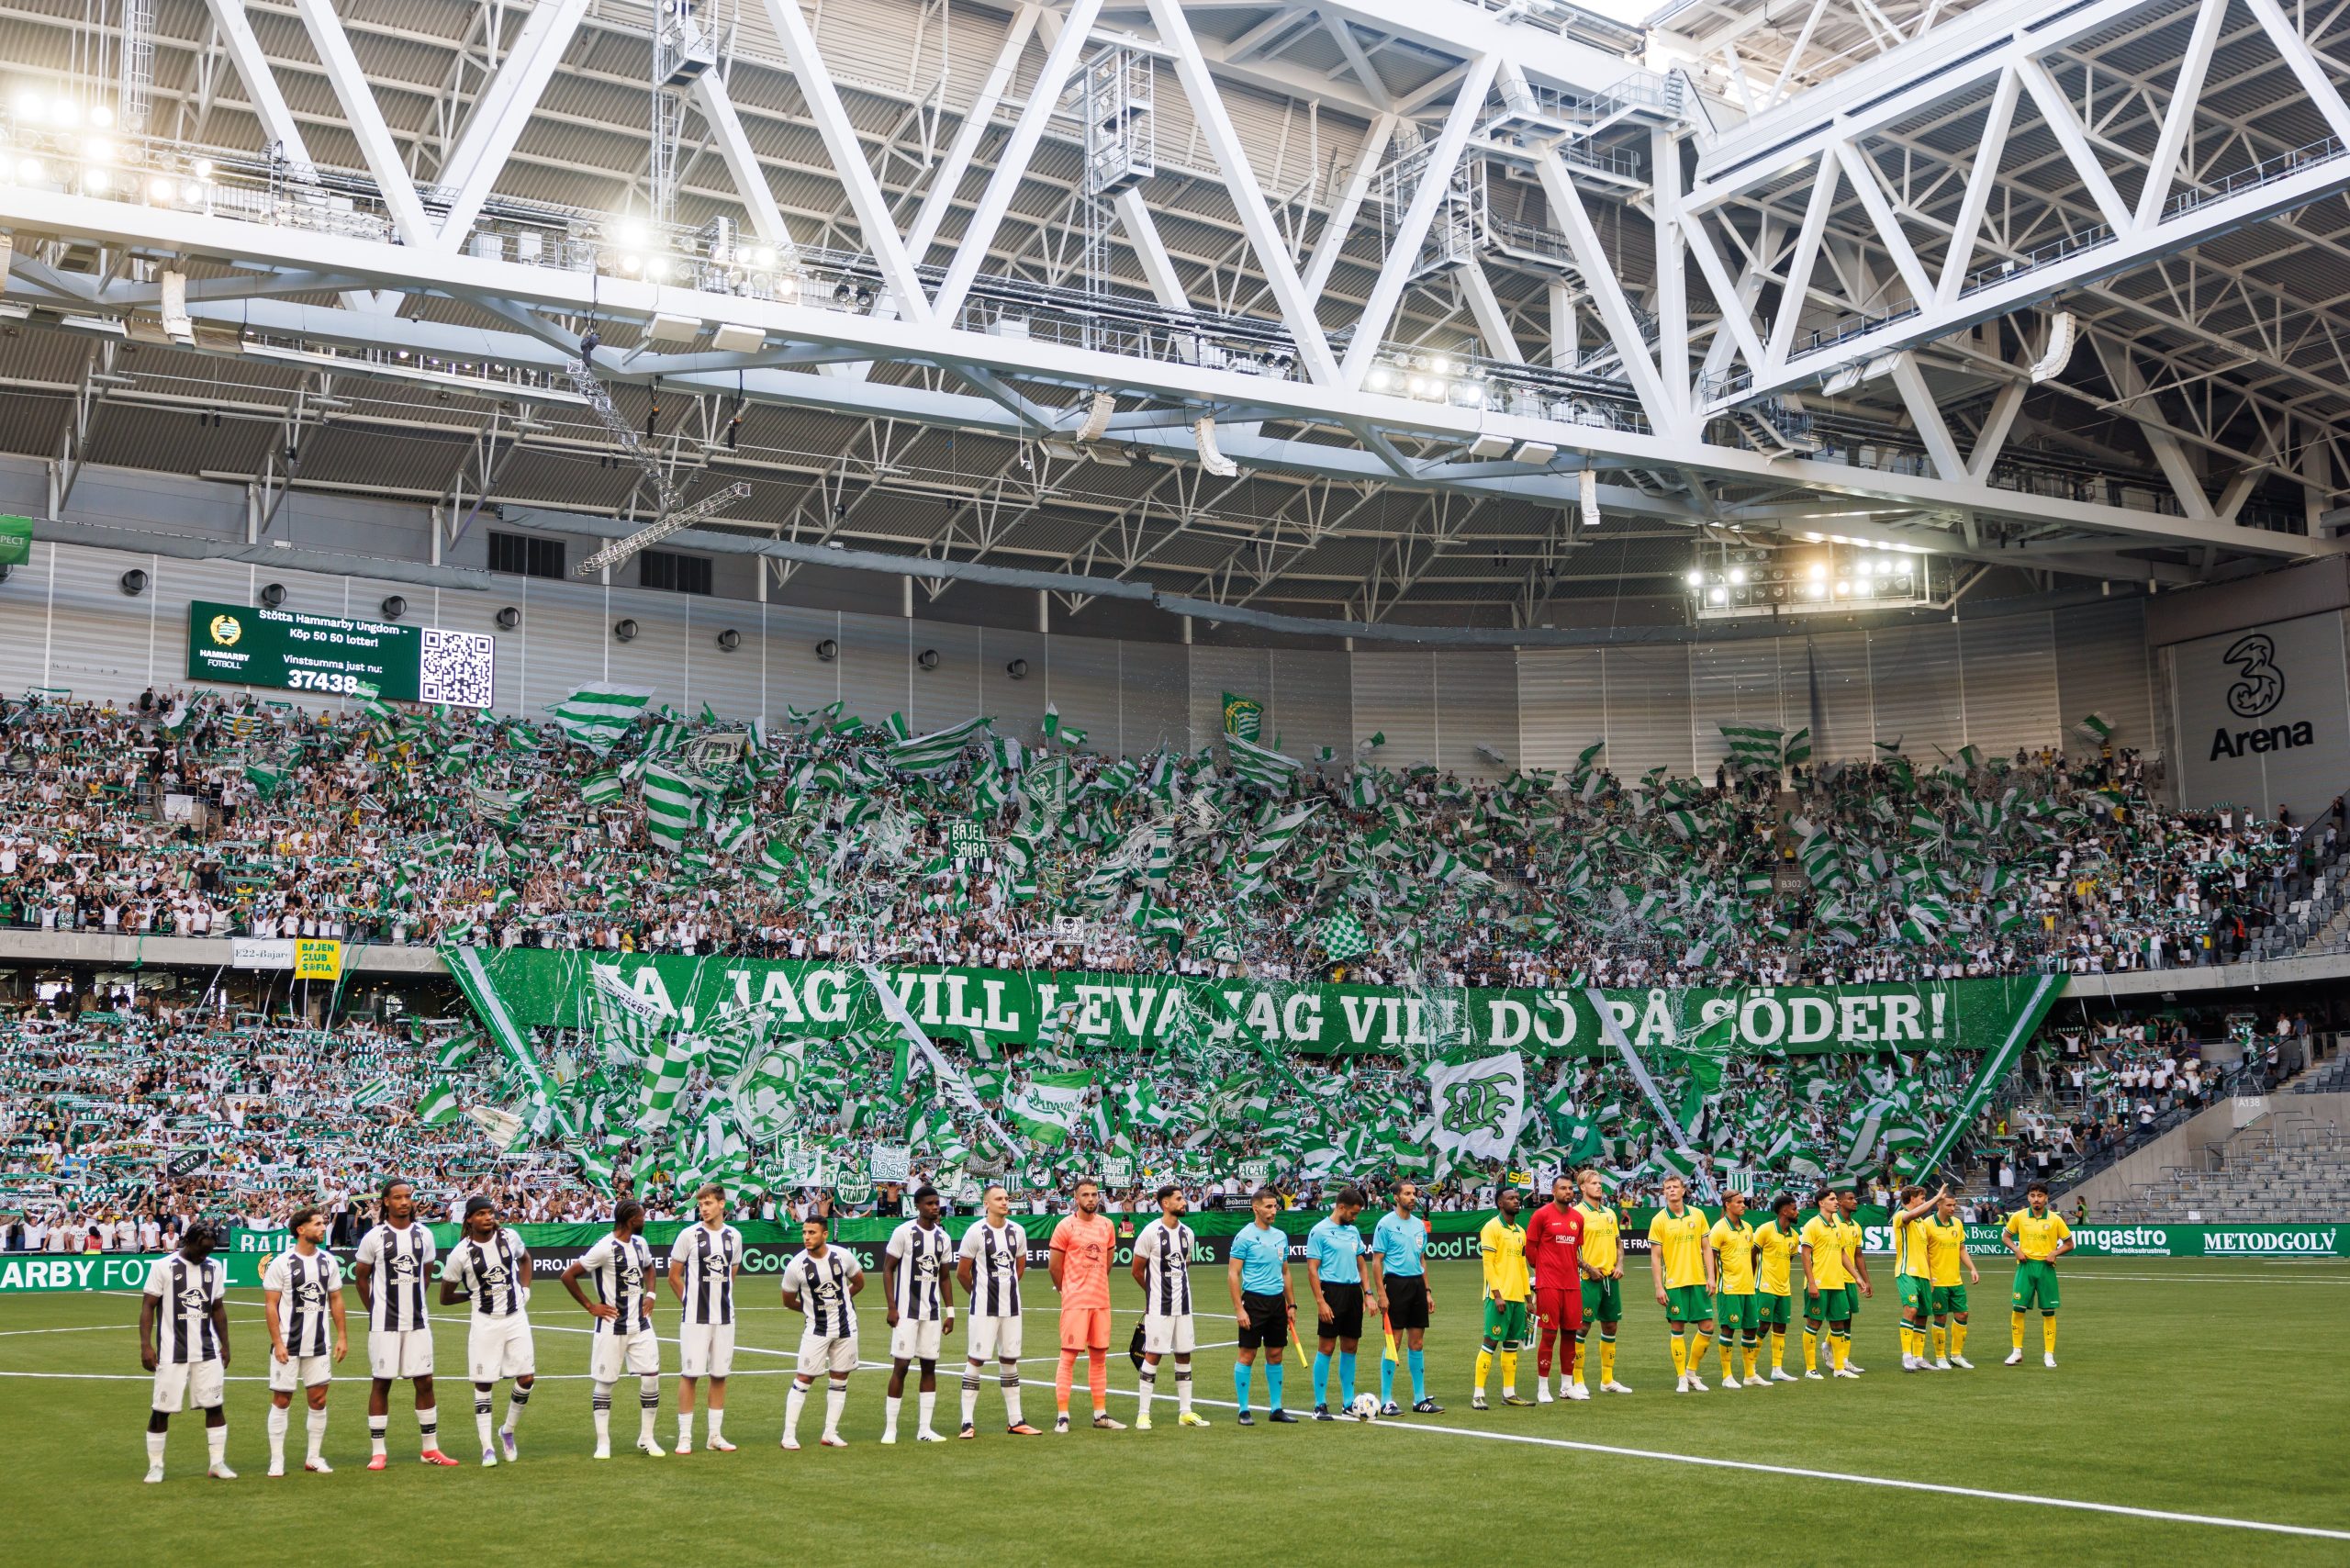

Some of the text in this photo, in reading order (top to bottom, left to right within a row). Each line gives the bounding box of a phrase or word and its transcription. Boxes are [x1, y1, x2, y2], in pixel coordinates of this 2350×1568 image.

[259, 610, 293, 622] Stötta
[296, 614, 353, 631] Hammarby
[356, 622, 399, 634] Ungdom
[289, 628, 378, 647] Köp 50 50 lotter!
[199, 649, 250, 662] HAMMARBY
[207, 659, 242, 669] FOTBOLL
[283, 655, 383, 673] Vinstsumma just nu:
[287, 669, 358, 692] 37438
[2210, 721, 2313, 761] Arena
[513, 766, 535, 776] OSCAR
[952, 841, 988, 858] SAMBA
[1781, 880, 1801, 889] B302
[302, 943, 334, 952] BAJEN
[302, 953, 328, 962] CLUB
[719, 969, 851, 1023] JAG
[1488, 990, 1577, 1047] DÖ
[2238, 1098, 2260, 1107] A138
[173, 1152, 200, 1172] YATZY
[871, 1161, 909, 1177] 1993
[1508, 1171, 1532, 1184] 96
[1555, 1234, 1576, 1242] PROJOB
[2203, 1231, 2336, 1251] METODGOLV
[2111, 1246, 2171, 1256] Storköksutrustning
[389, 1277, 420, 1285] NAPOLEON
